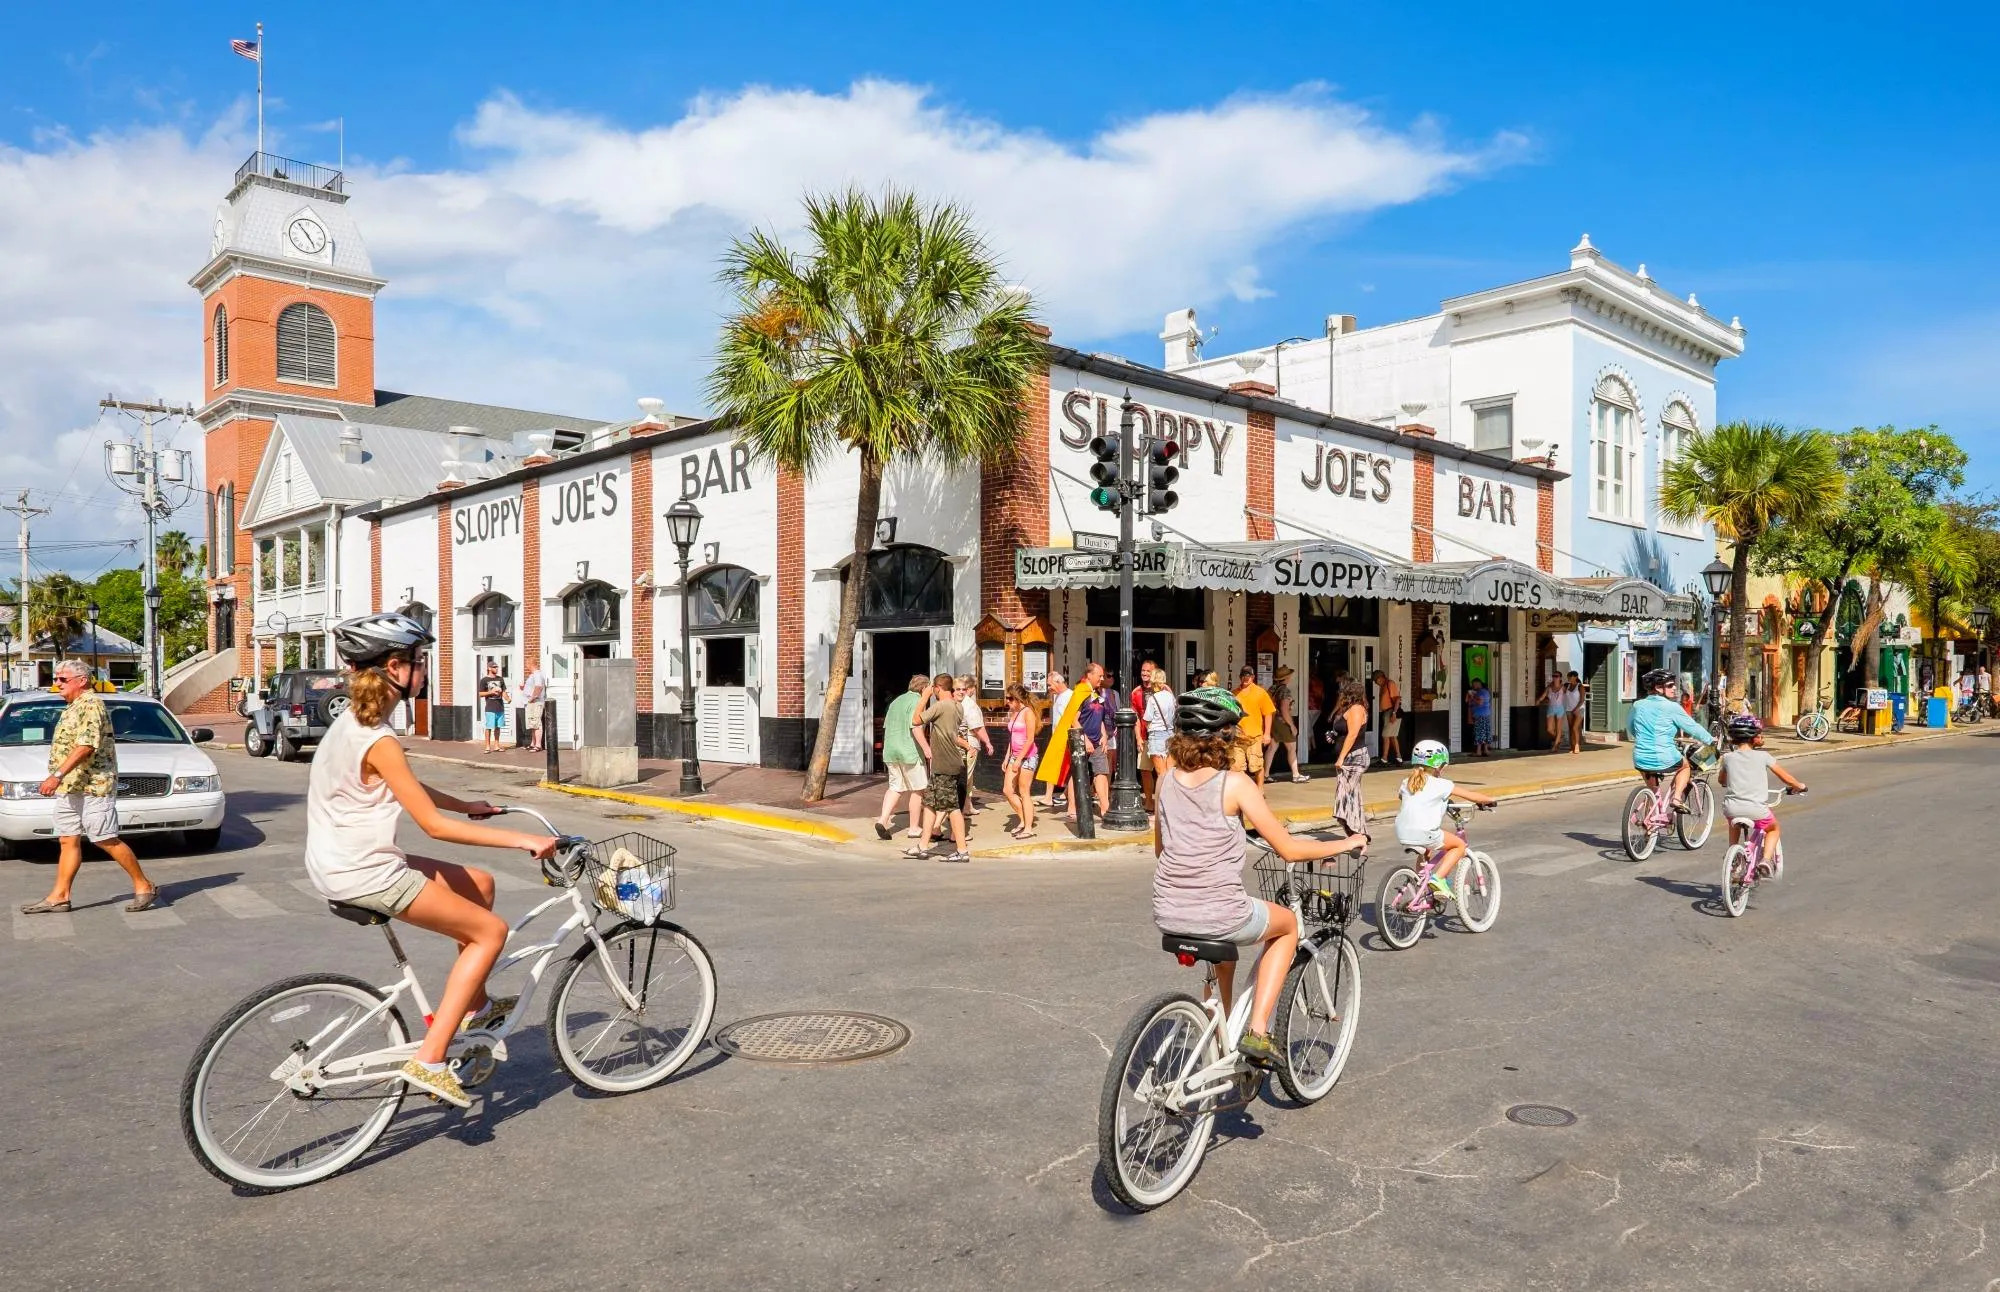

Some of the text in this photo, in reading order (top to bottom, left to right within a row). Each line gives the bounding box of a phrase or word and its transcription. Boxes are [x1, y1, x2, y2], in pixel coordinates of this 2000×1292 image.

[1059, 390, 1234, 476] SLOPPY
[681, 441, 752, 500] BAR
[1301, 443, 1392, 504] JOE'S
[552, 472, 618, 526] JOE'S
[1457, 474, 1517, 526] BAR
[455, 495, 523, 546] SLOPPY
[1084, 537, 1102, 548] Duval
[1132, 551, 1166, 571] BAR
[1200, 559, 1257, 581] Cocktails
[1274, 558, 1380, 590] SLOPPY
[1488, 579, 1541, 605] JOE'S
[1620, 593, 1648, 615] BAR
